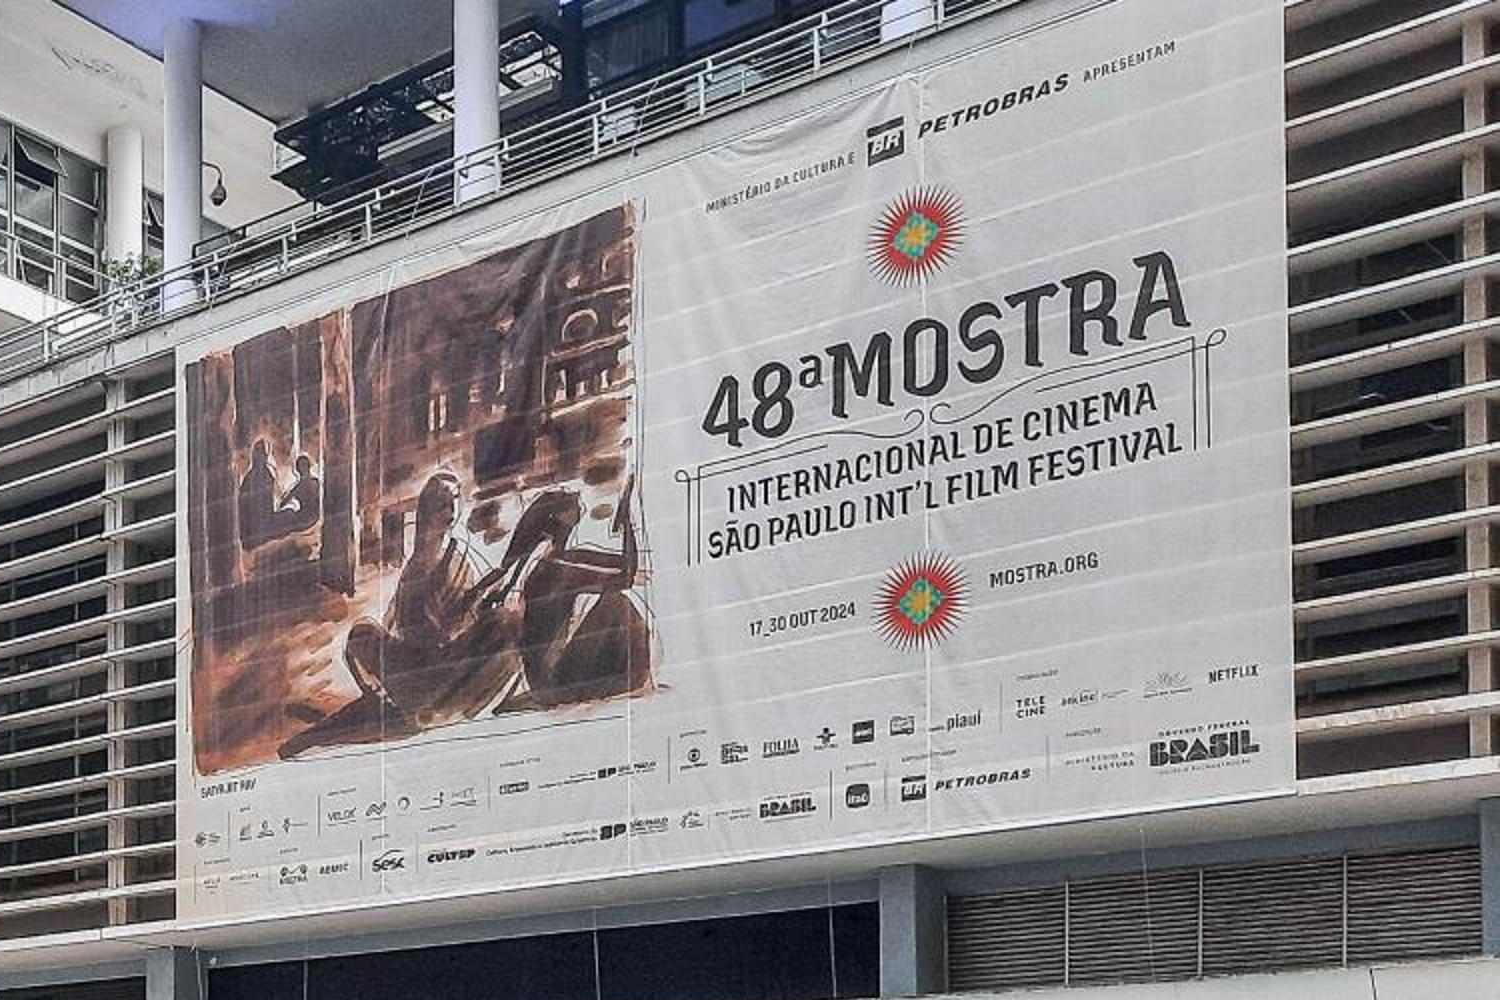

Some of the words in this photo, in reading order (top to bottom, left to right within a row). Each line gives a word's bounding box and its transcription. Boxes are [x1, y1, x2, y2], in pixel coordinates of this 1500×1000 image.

[774, 174, 791, 190] DA
[792, 156, 846, 183] CULTURA
[917, 73, 1069, 139] PETROBRAS
[1082, 40, 1176, 83] APRESENTAM
[825, 250, 1192, 419] MOSTRA
[725, 430, 967, 515] INTERNACIONAL
[973, 417, 1014, 457] DE
[1021, 381, 1159, 443] CINEMA
[706, 520, 761, 560] SÃO
[767, 499, 857, 546] PAULO
[863, 479, 941, 528] INT'L
[945, 459, 1021, 510] FILM
[1026, 422, 1185, 490] FESTIVAL
[988, 551, 1100, 590] MOSTRA.ORG
[788, 609, 819, 631] OUT
[820, 600, 857, 625] 2024
[1208, 663, 1259, 685] NETFLIX
[1016, 706, 1046, 719] CINE
[1149, 730, 1261, 767] BRASIL
[935, 768, 1032, 791] PETROBRAS
[759, 798, 817, 819] BRASIL
